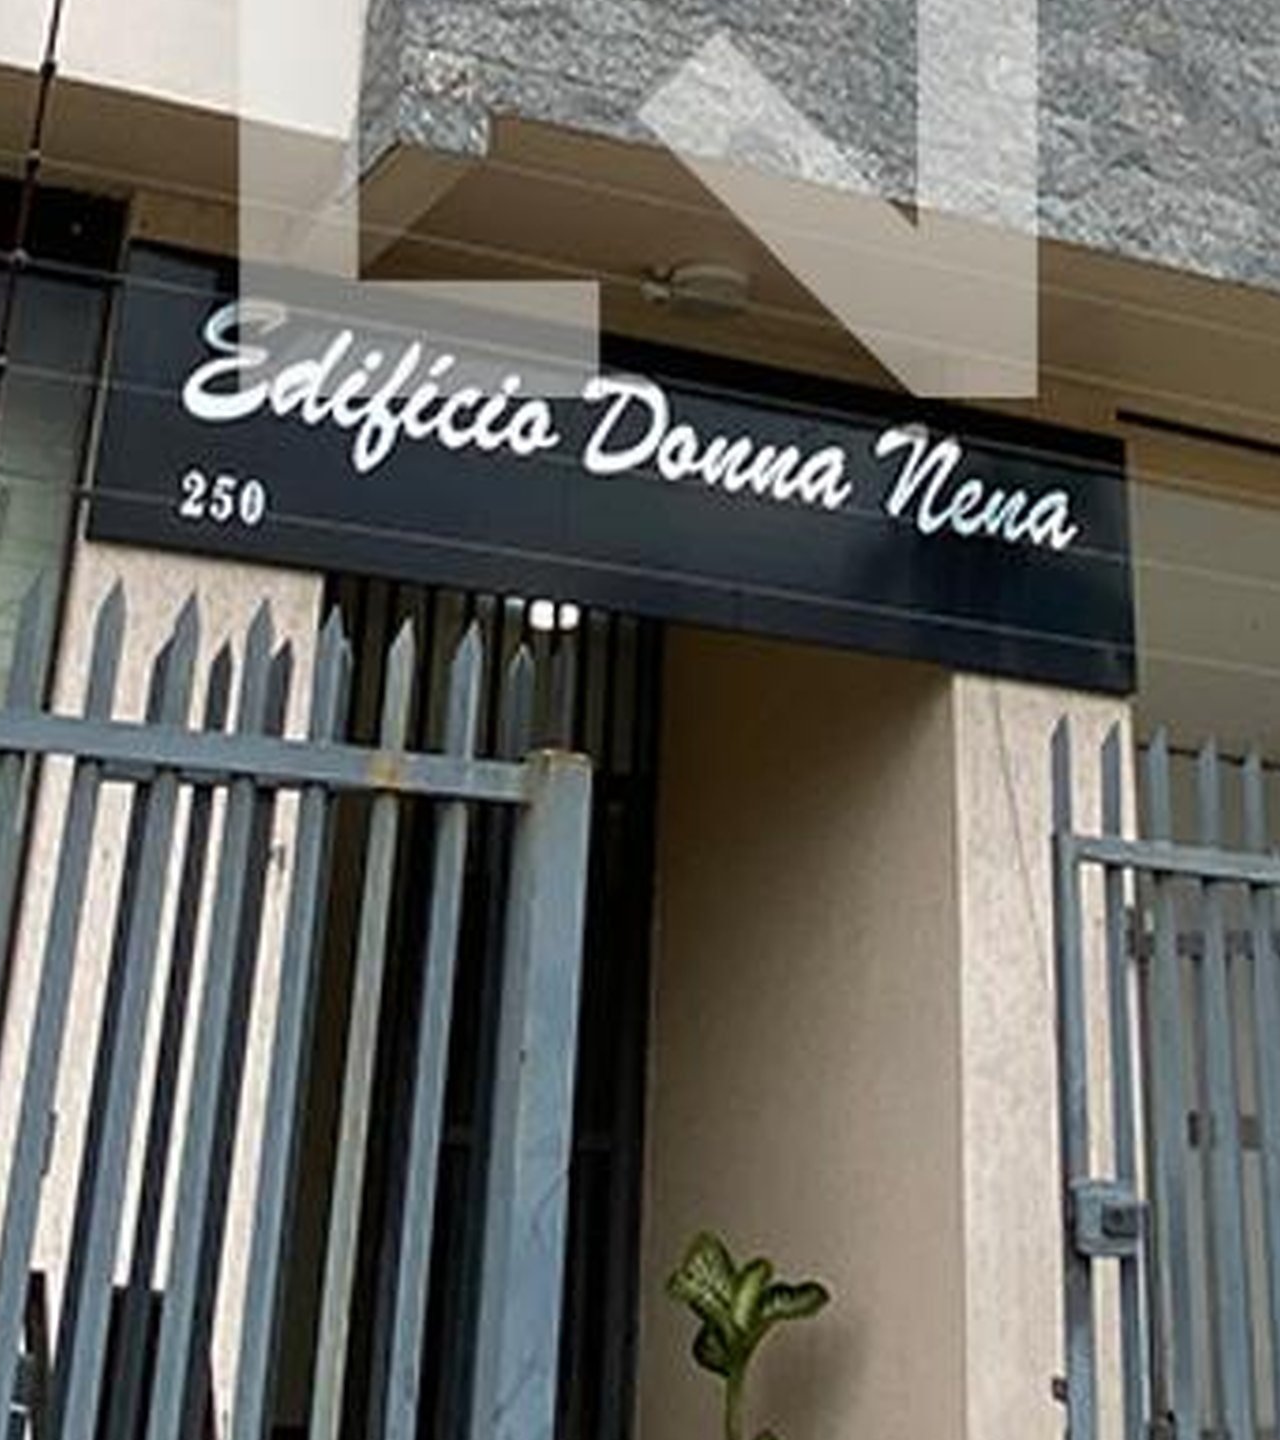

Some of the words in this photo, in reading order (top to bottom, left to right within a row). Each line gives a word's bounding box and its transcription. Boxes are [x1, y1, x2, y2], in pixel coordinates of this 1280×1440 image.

[179, 469, 266, 526] 250
[182, 300, 560, 472] Edifício
[581, 375, 853, 510] Donna
[875, 426, 1078, 550] Nena
